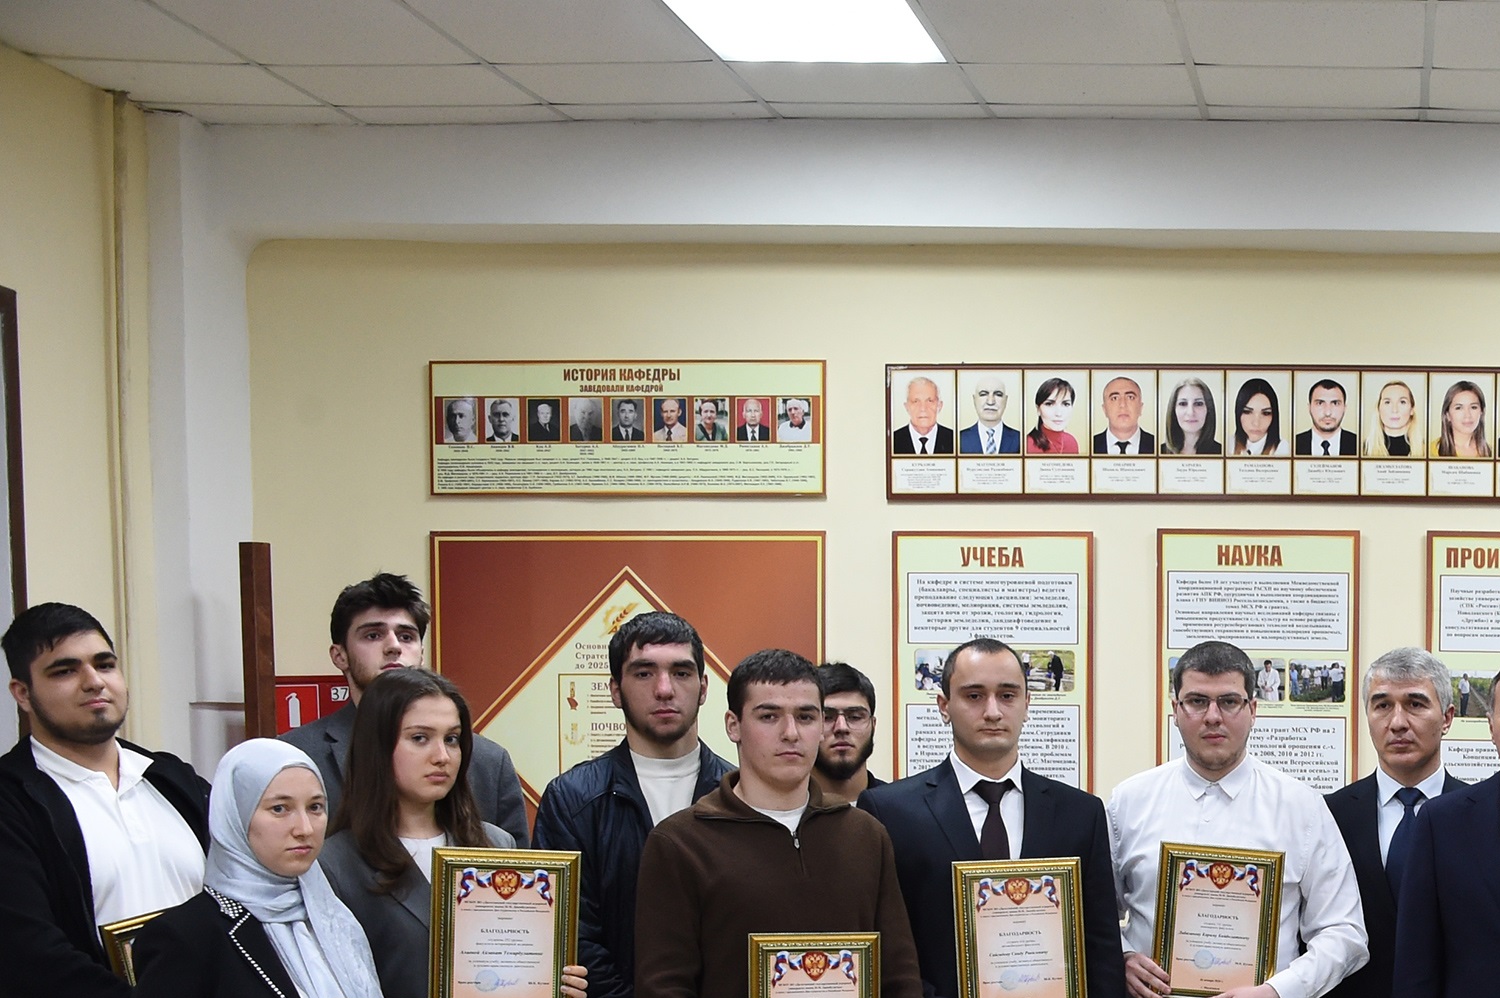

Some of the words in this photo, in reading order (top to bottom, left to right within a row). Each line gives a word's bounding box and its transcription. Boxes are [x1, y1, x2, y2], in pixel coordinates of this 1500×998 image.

[563, 368, 616, 381] ИСТОРИЯ
[619, 368, 680, 382] КАФЕДРЫ
[579, 385, 624, 393] ЗАВЕДОВАЛИ
[626, 383, 664, 393] КАФЕДРОЙ
[960, 546, 1024, 568] УЧЕБА
[1217, 544, 1282, 566] НАУКА
[331, 687, 349, 701] 37
[591, 723, 626, 731] ПОЧВО
